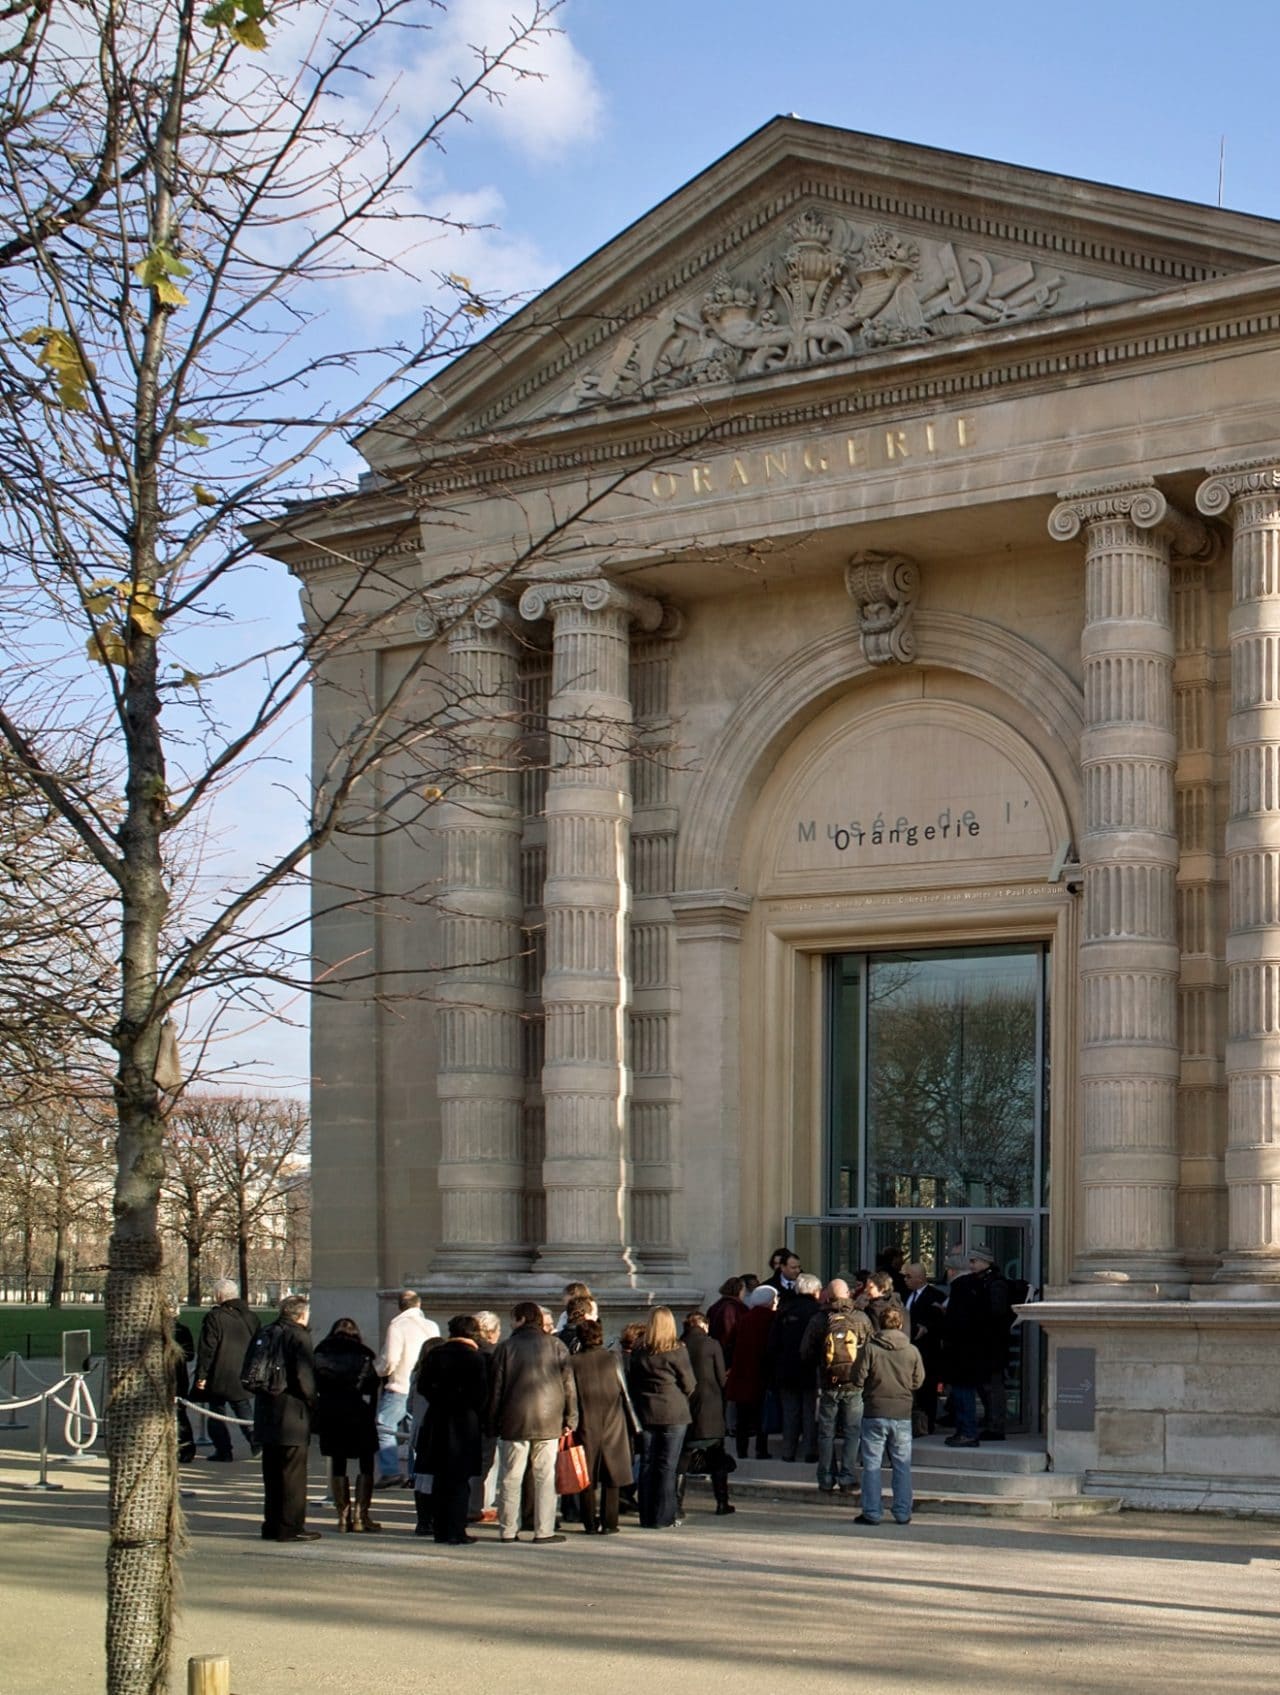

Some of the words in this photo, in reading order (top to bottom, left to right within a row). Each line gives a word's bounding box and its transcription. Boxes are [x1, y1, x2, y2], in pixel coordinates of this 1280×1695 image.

[651, 416, 977, 499] ORANGERIE
[798, 811, 909, 842] Musée
[938, 807, 976, 828] de
[835, 818, 980, 850] Orangerie
